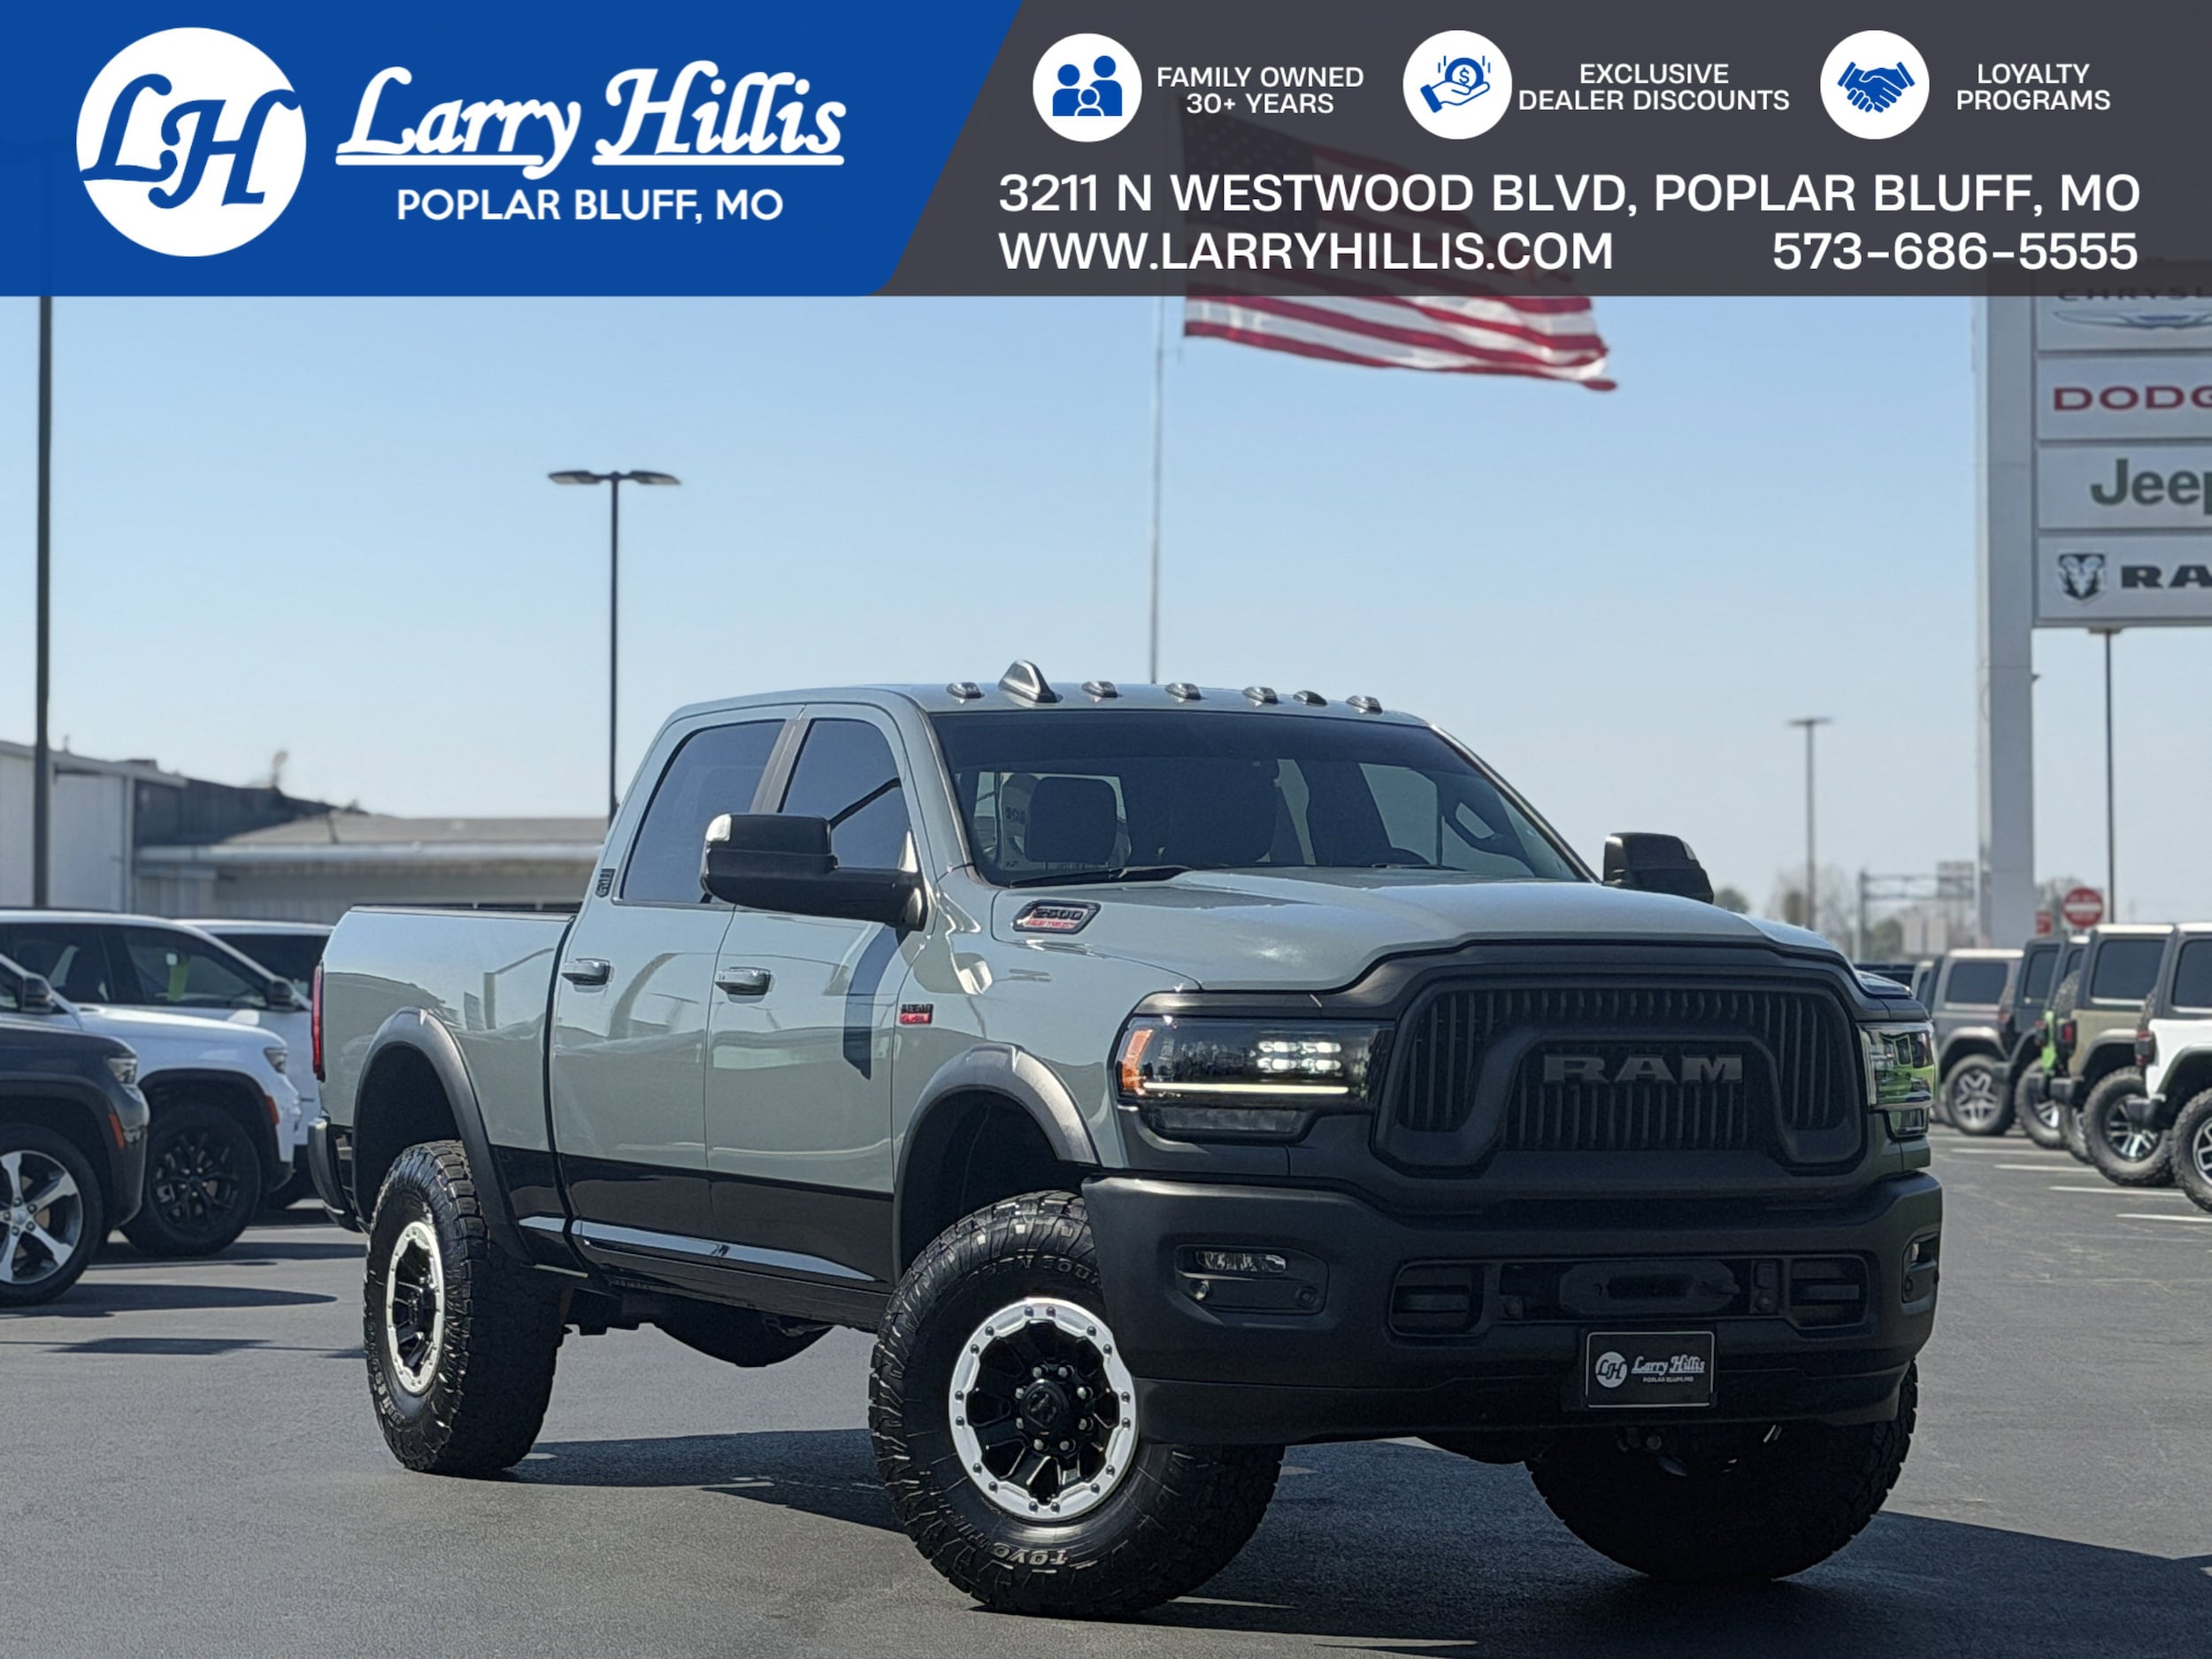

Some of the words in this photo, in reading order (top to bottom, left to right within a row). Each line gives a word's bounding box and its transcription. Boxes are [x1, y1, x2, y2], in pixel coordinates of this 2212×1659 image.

[2090, 457, 2212, 516] Jee
[1543, 1054, 1743, 1084] RAM
[1631, 1356, 1669, 1376] Larry
[1669, 1354, 1706, 1374] Hillis
[992, 1542, 1068, 1565] TOYO
